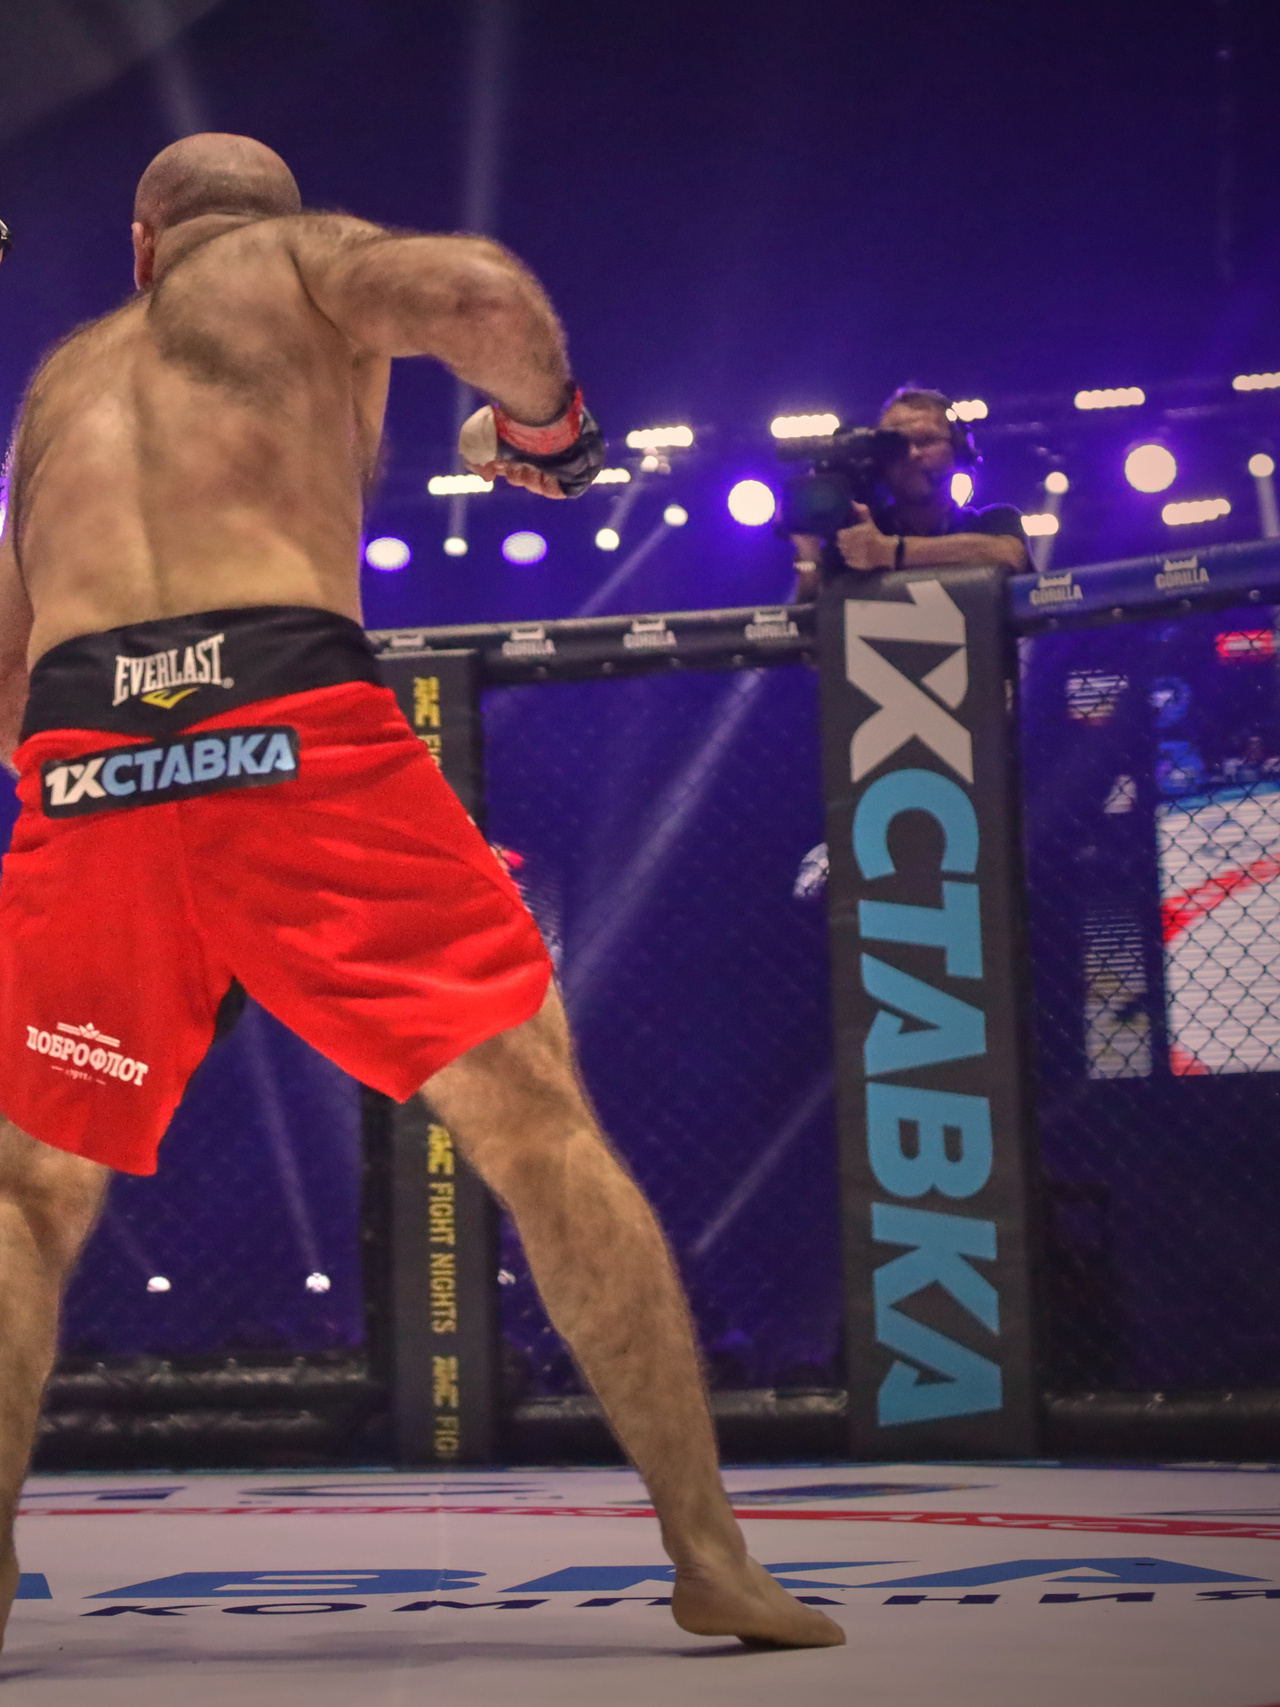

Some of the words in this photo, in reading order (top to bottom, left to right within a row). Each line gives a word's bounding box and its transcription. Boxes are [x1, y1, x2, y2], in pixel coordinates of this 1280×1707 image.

[1155, 566, 1210, 589] GORILLA
[112, 633, 225, 707] EVERLAST
[428, 1182, 456, 1246] FIGHT
[429, 1252, 458, 1334] NIGHTS
[434, 1416, 461, 1458] FIG
